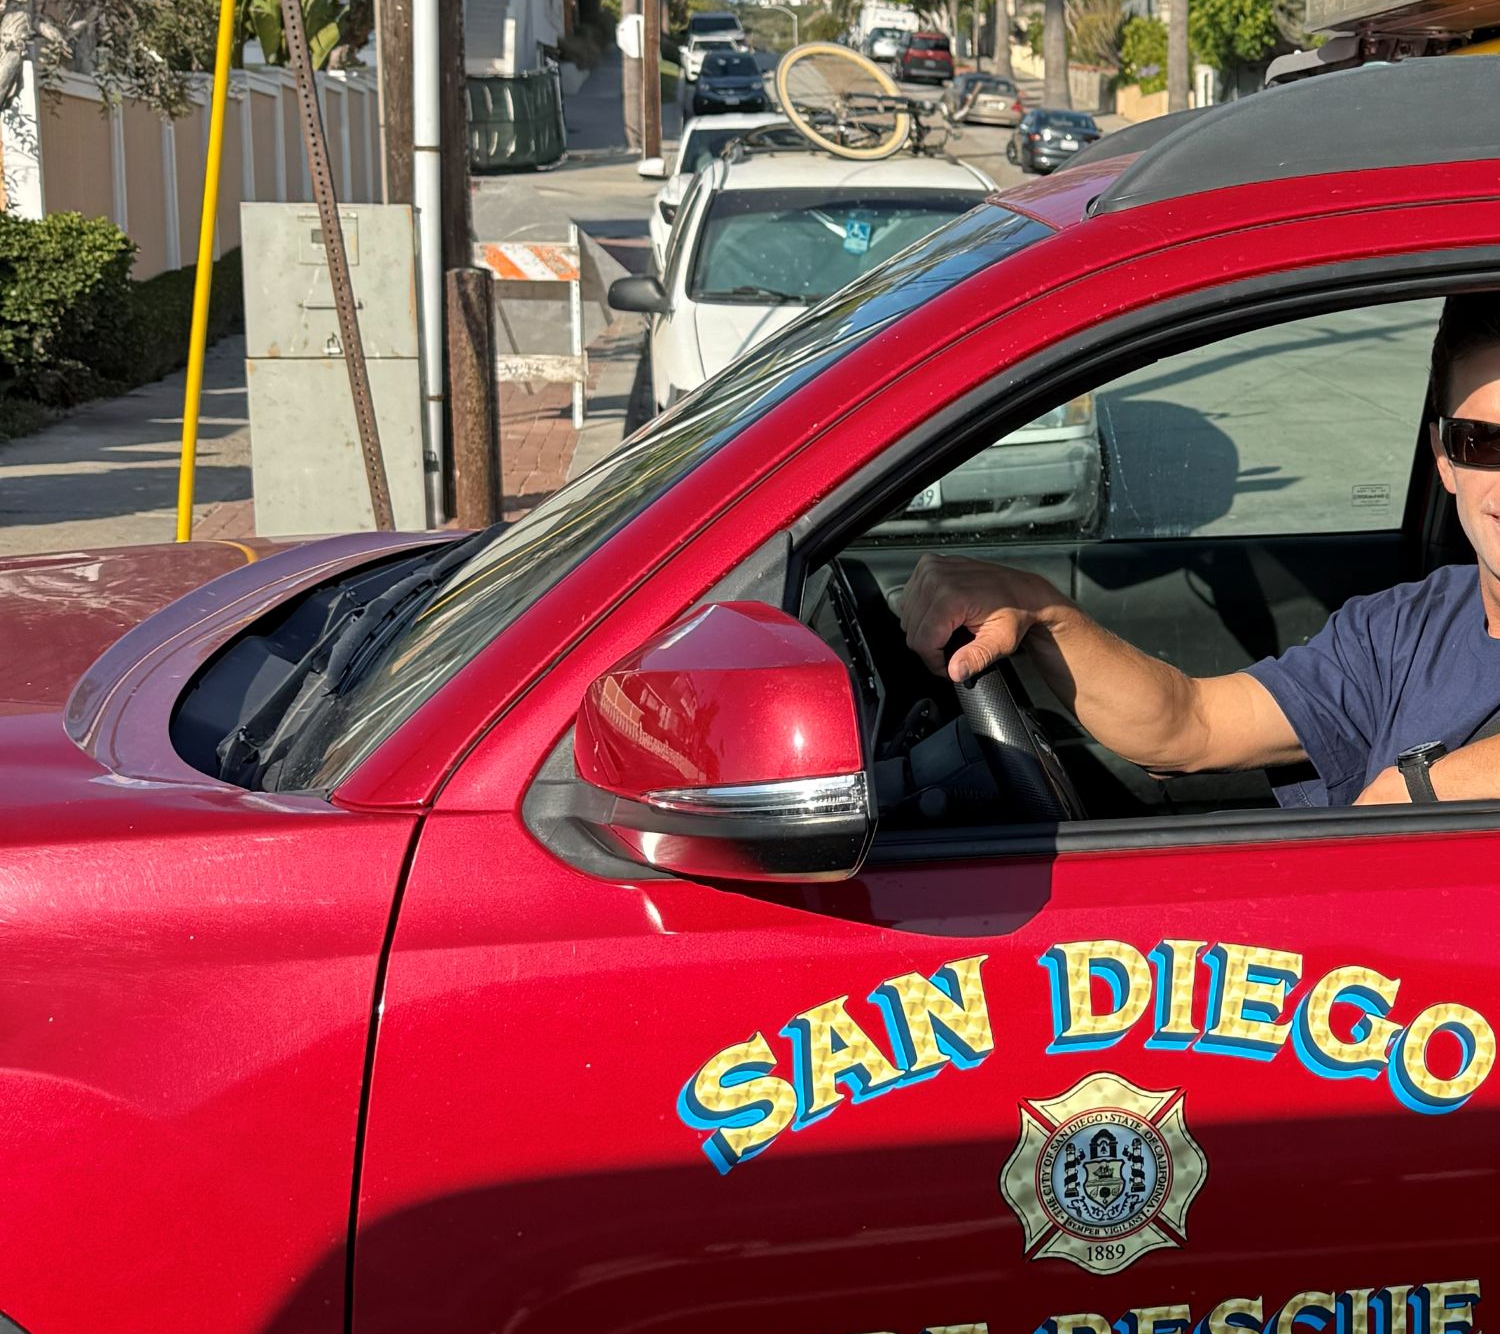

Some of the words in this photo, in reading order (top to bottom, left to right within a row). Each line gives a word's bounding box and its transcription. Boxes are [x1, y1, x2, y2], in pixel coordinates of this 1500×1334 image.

[677, 954, 997, 1175] SAN
[1038, 938, 1496, 1116] DIEGO
[1069, 1113, 1103, 1136] DIEGO
[1109, 1113, 1143, 1132] STATE
[1051, 1130, 1070, 1152] SAN
[1144, 1130, 1159, 1147] OF
[1043, 1151, 1055, 1167] OF
[1041, 1169, 1052, 1197] CITY
[1147, 1145, 1168, 1209] CALIFORNIA
[1046, 1195, 1063, 1219] THE
[1067, 1217, 1100, 1236] SEMPER
[1086, 1244, 1126, 1262] 1889
